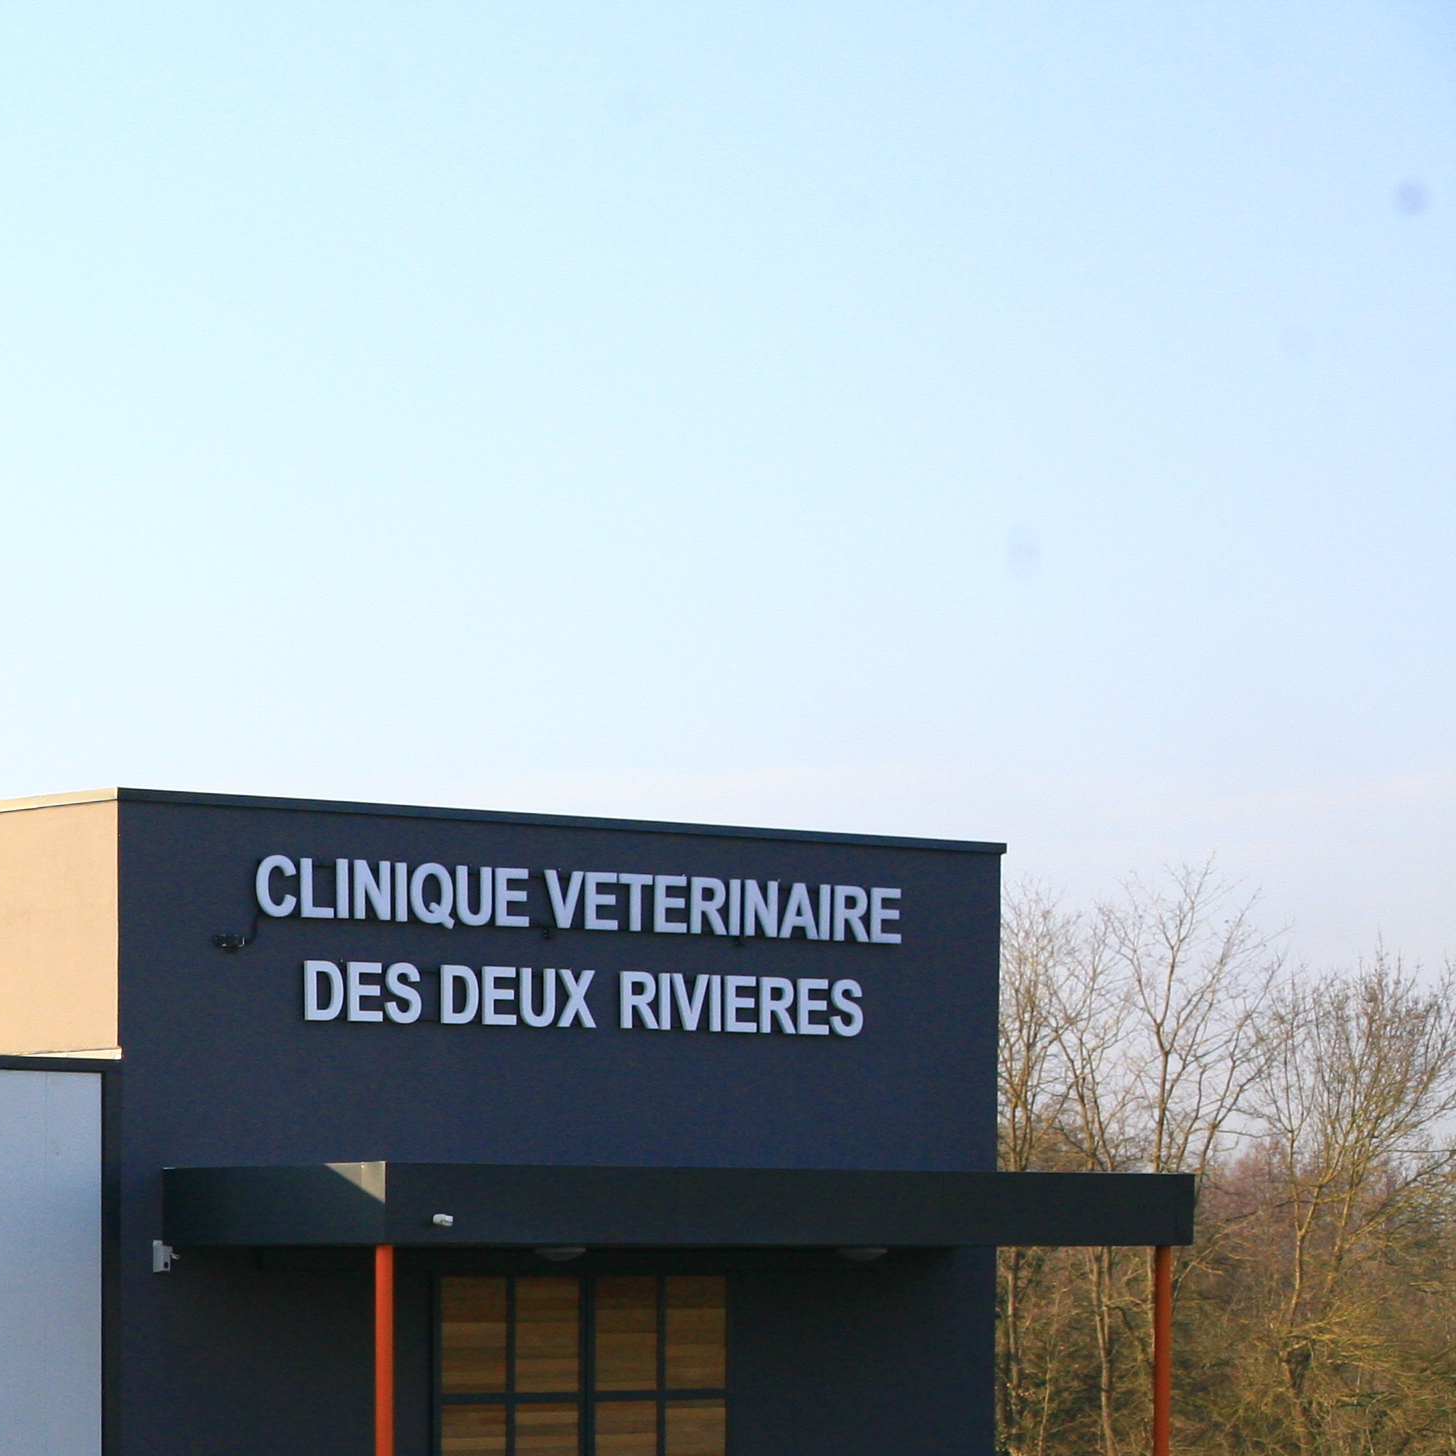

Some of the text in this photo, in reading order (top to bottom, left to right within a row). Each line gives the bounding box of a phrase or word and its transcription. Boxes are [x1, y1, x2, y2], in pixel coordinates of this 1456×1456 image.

[255, 854, 902, 943] CLINIQUE VETERINAIRE
[304, 960, 864, 1037] DES DEUX RIVIERES
